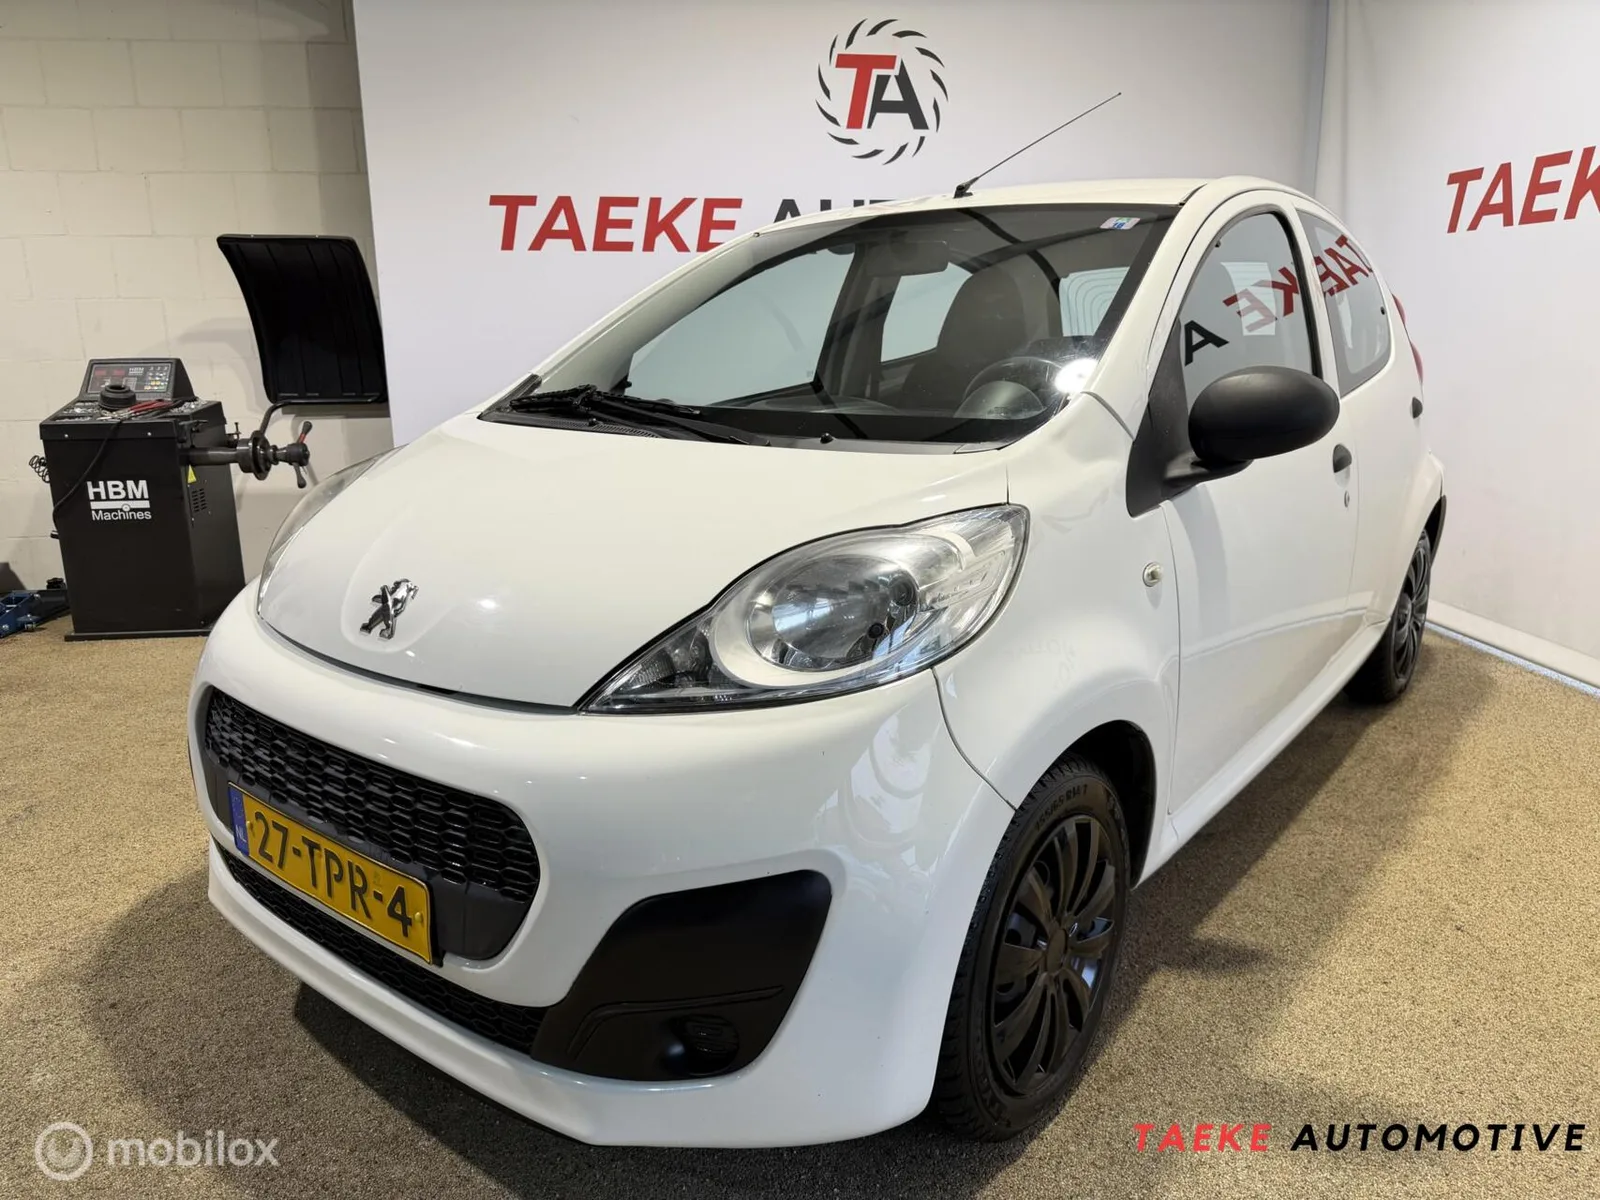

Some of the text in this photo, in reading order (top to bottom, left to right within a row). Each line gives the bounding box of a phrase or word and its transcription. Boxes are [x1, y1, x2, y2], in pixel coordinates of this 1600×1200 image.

[835, 53, 929, 130] TA
[489, 194, 743, 253] TAEKE
[87, 480, 149, 500] HBM
[91, 510, 152, 521] Machines
[255, 811, 413, 938] 27-TPR-4
